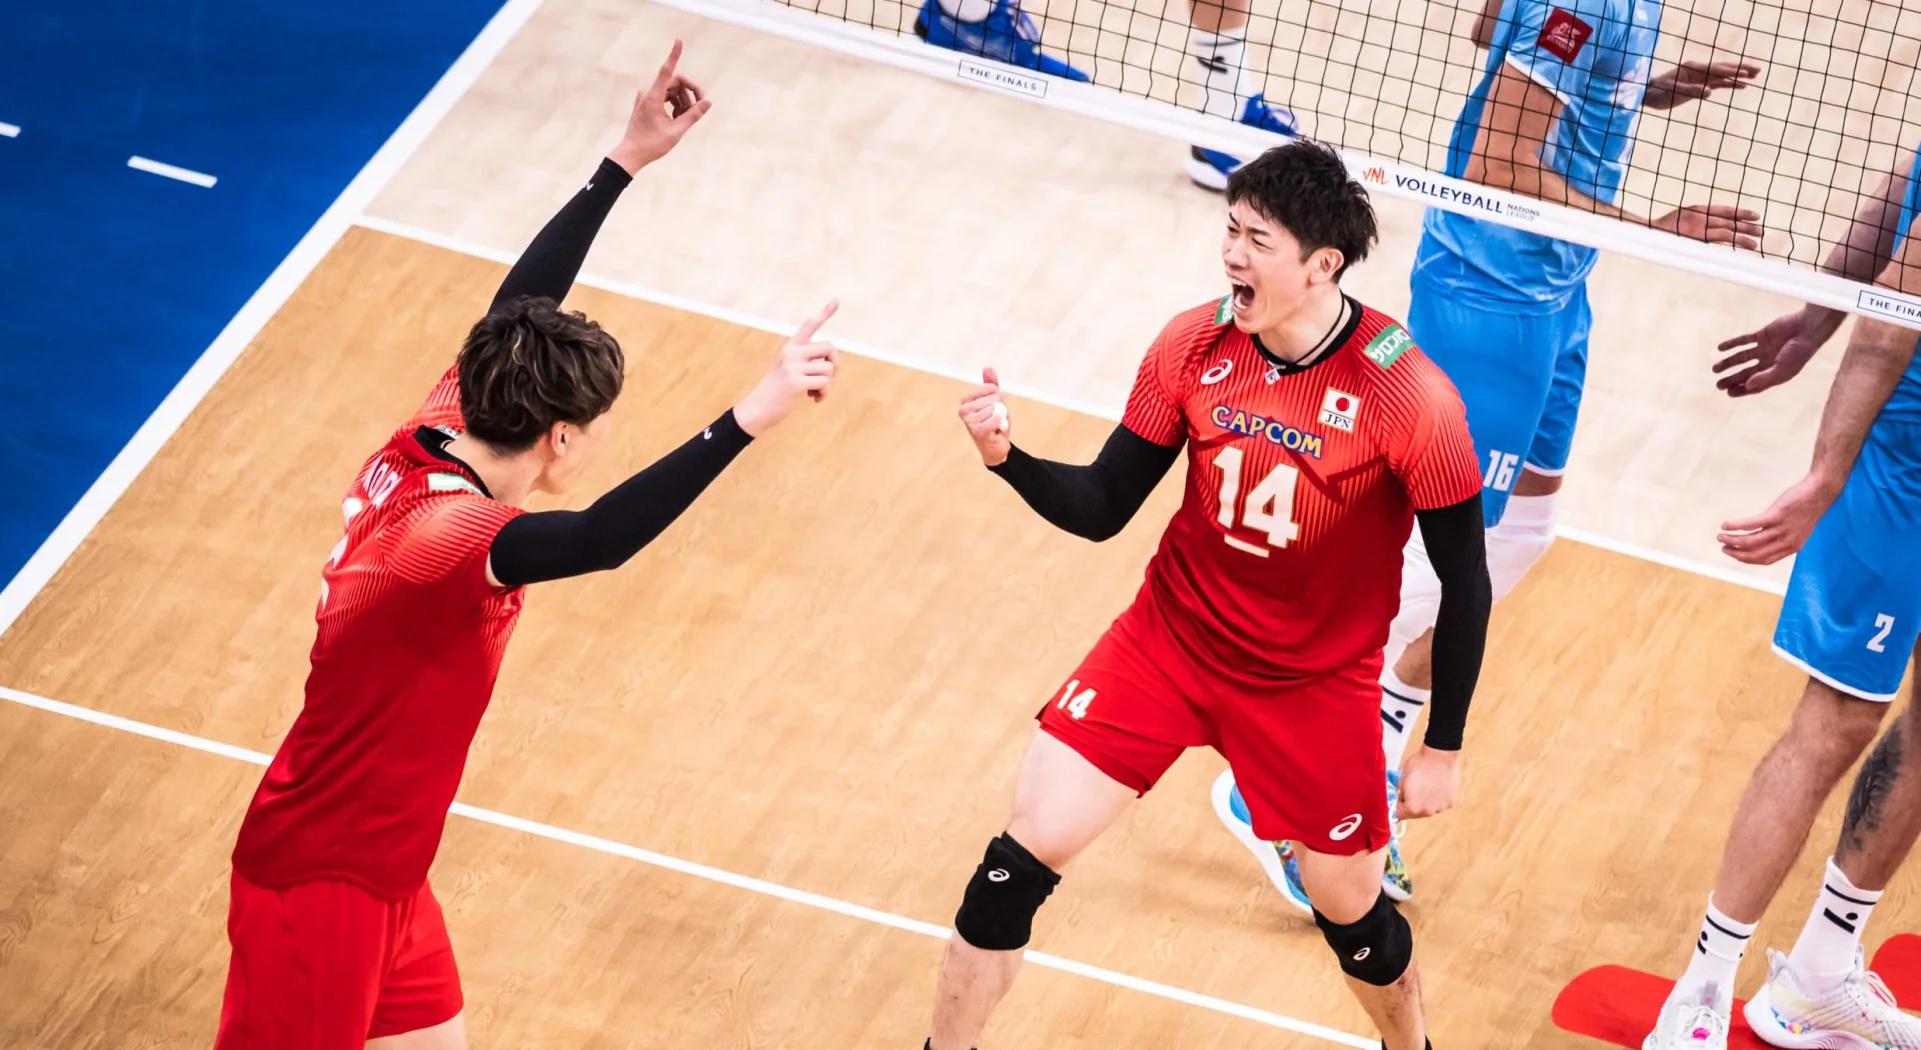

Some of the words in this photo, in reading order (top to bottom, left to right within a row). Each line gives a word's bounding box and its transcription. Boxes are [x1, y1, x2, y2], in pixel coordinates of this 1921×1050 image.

[969, 67, 990, 78] THE
[996, 74, 1037, 91] FINALS
[1362, 166, 1390, 186] VNL
[1395, 174, 1503, 214] VOLLEYBALL
[1507, 204, 1540, 217] NATIONS
[1870, 298, 1890, 310] THE
[1210, 405, 1325, 460] CAPCOM
[1324, 413, 1352, 429] JPN
[1482, 449, 1519, 491] 16
[1212, 445, 1300, 549] 14
[1866, 612, 1895, 653] 2
[1056, 678, 1098, 720] 14
